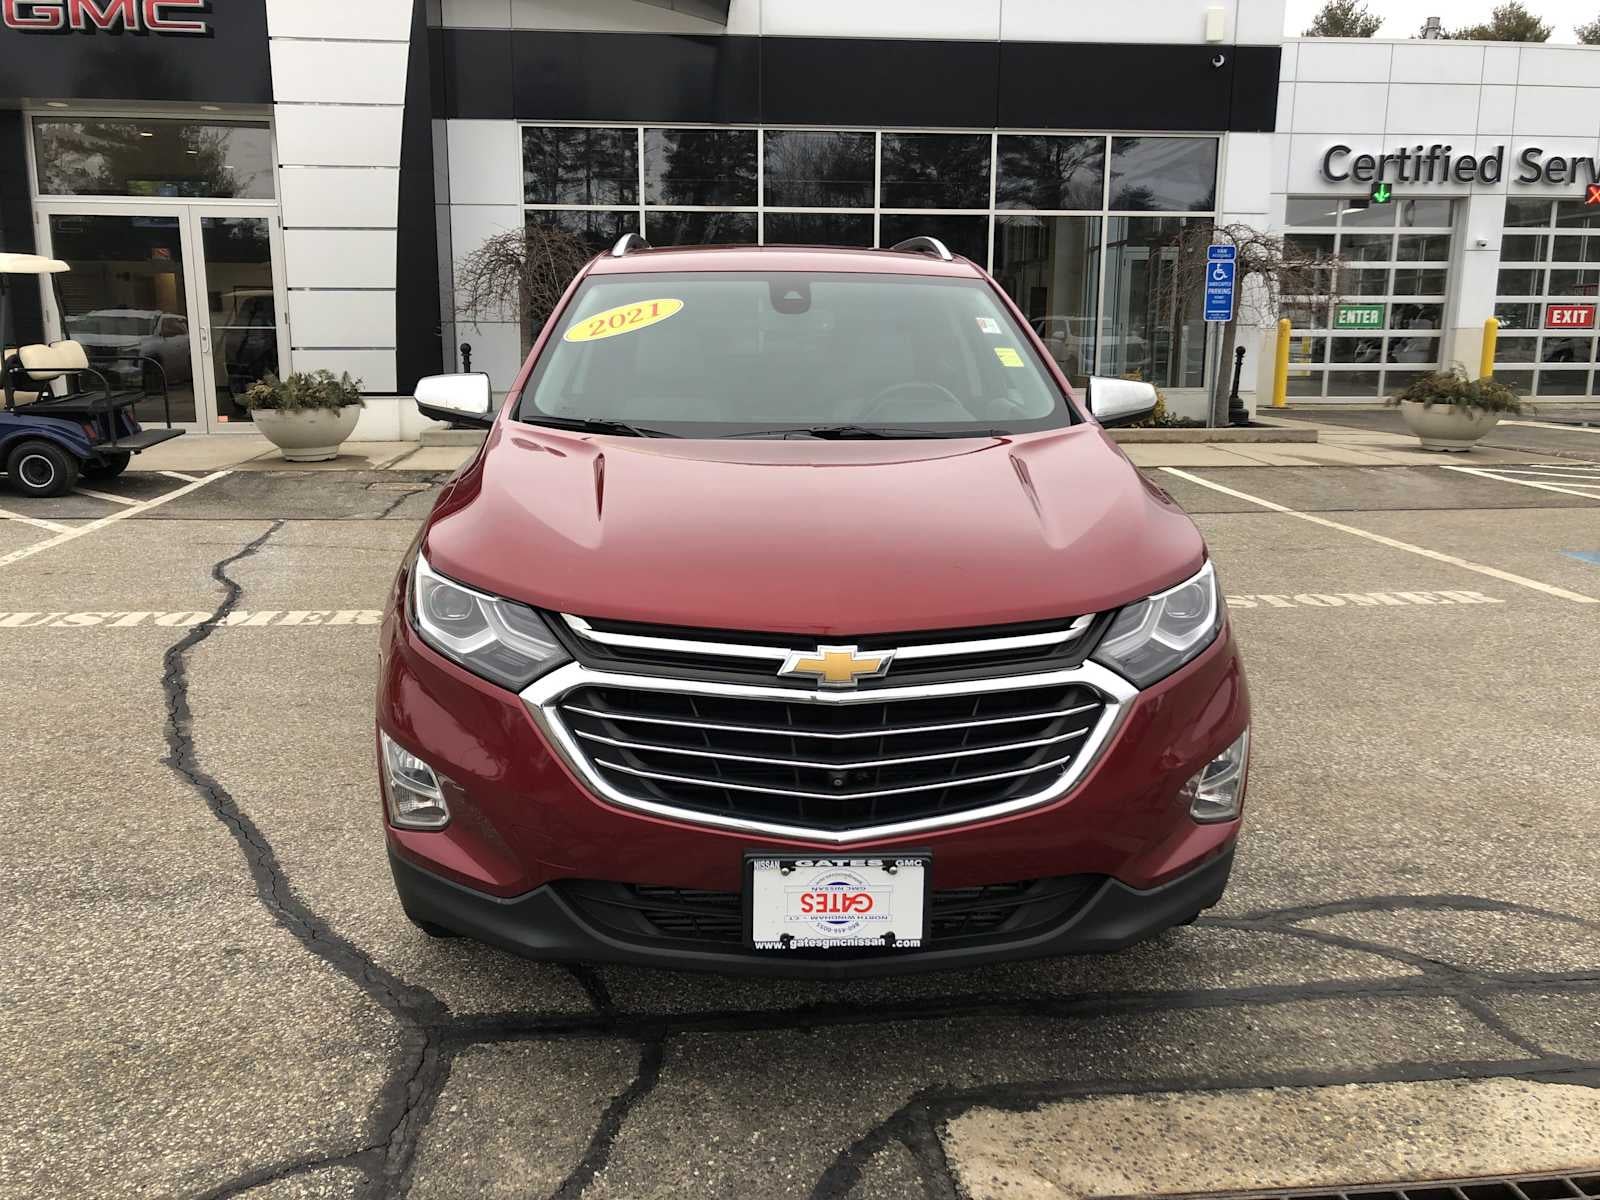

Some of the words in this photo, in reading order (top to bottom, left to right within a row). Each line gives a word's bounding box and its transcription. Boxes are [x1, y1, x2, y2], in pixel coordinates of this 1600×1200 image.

[2, 0, 207, 34] GMC
[1323, 144, 1504, 183] Certified
[589, 302, 662, 337] 2021
[1338, 310, 1379, 324] ENTER
[1551, 310, 1589, 324] EXIT
[0, 609, 384, 627] USTOMER
[753, 860, 781, 870] NISSAN
[794, 859, 884, 867] GATES
[895, 859, 923, 867] GMC
[800, 893, 873, 913] GATES
[754, 940, 786, 949] www.
[789, 937, 886, 949] gatesgmcnissan
[891, 938, 921, 948] .com
